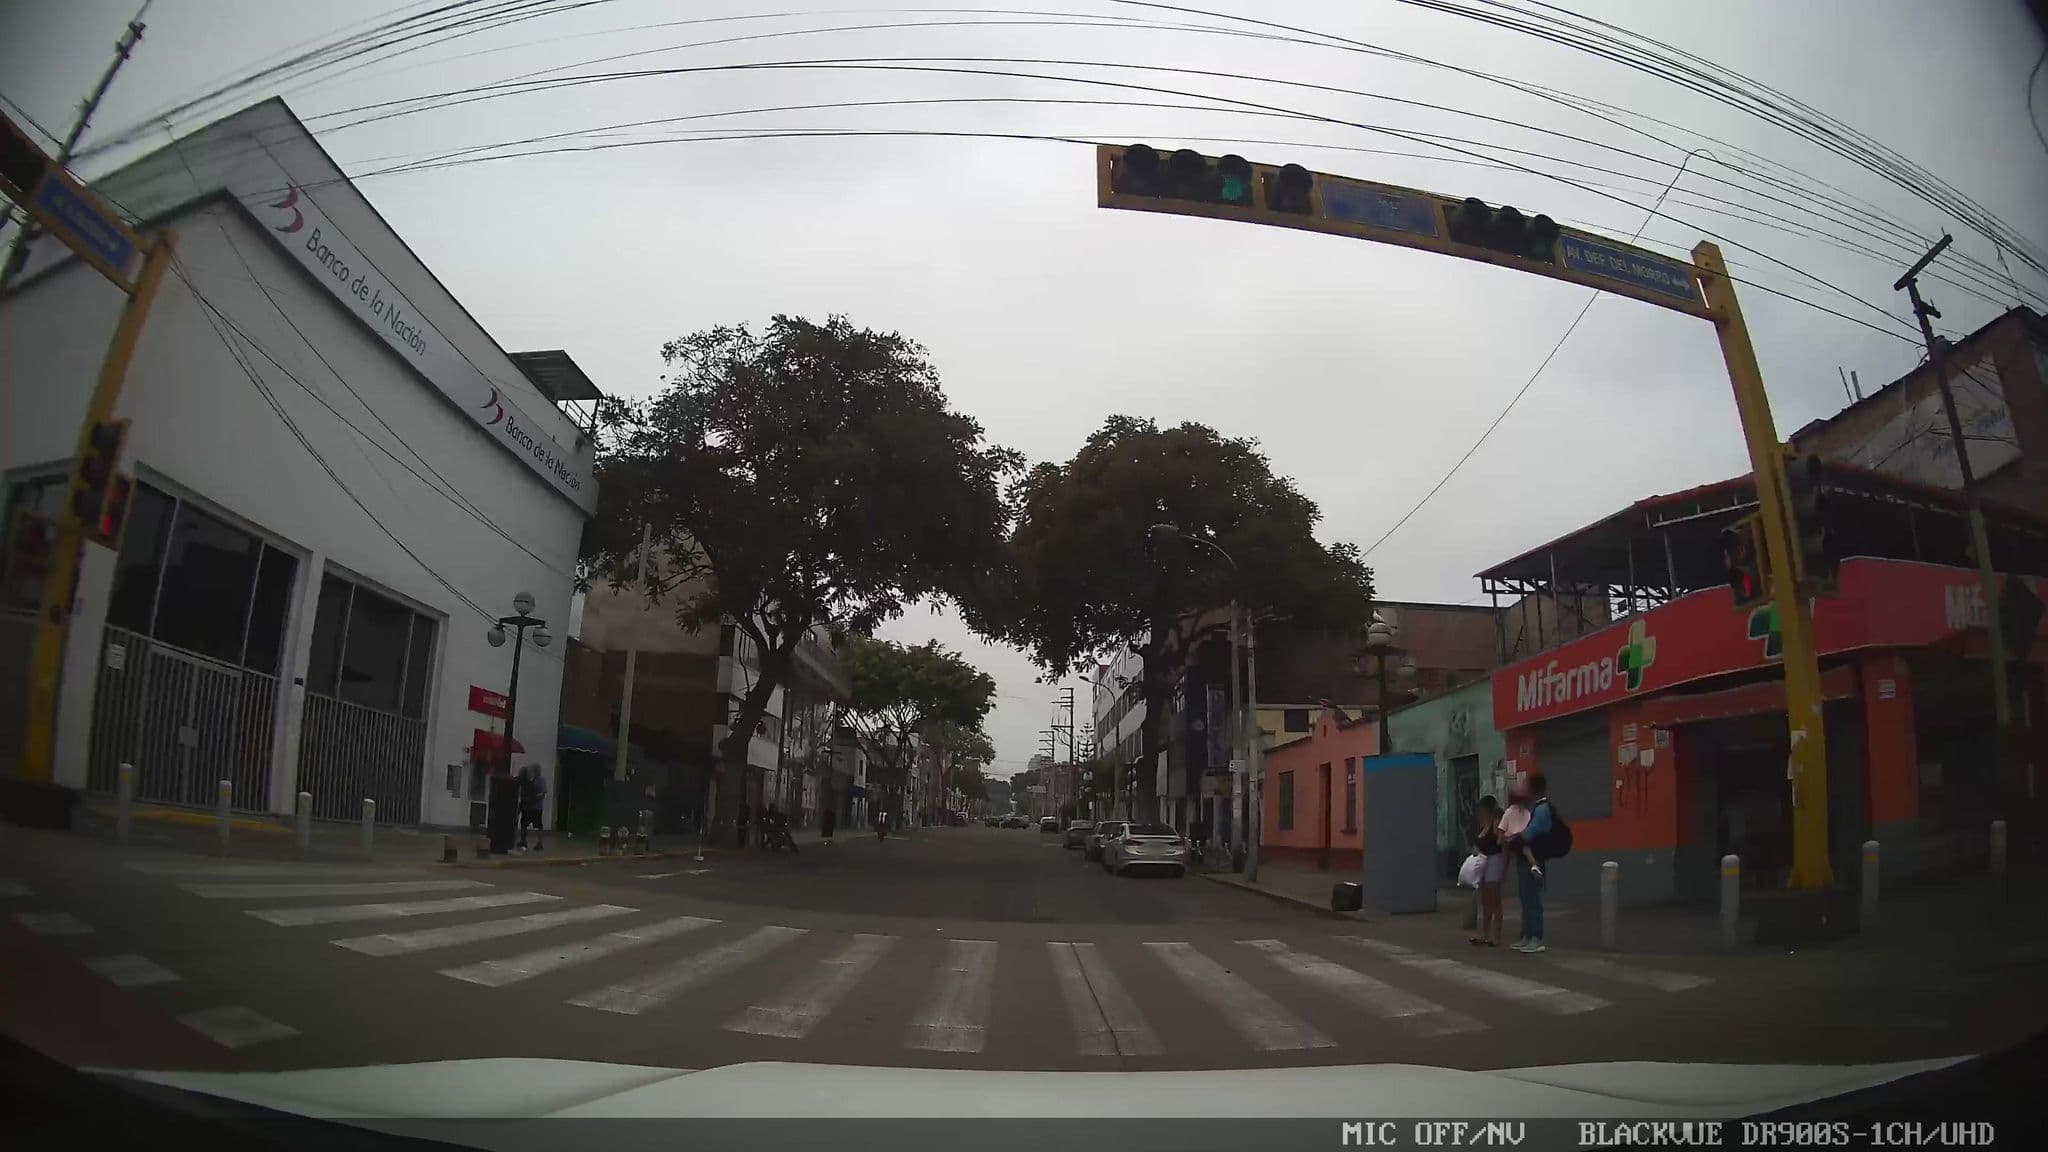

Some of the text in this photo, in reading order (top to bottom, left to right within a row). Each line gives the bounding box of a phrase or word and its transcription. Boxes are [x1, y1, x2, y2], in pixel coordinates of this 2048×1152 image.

[306, 228, 427, 356] Banco de la Nación
[1609, 256, 1630, 272] DEL
[1632, 263, 1670, 285] MORRO
[506, 416, 581, 491] Banco de la Nación
[1517, 655, 1613, 713] Mifarma
